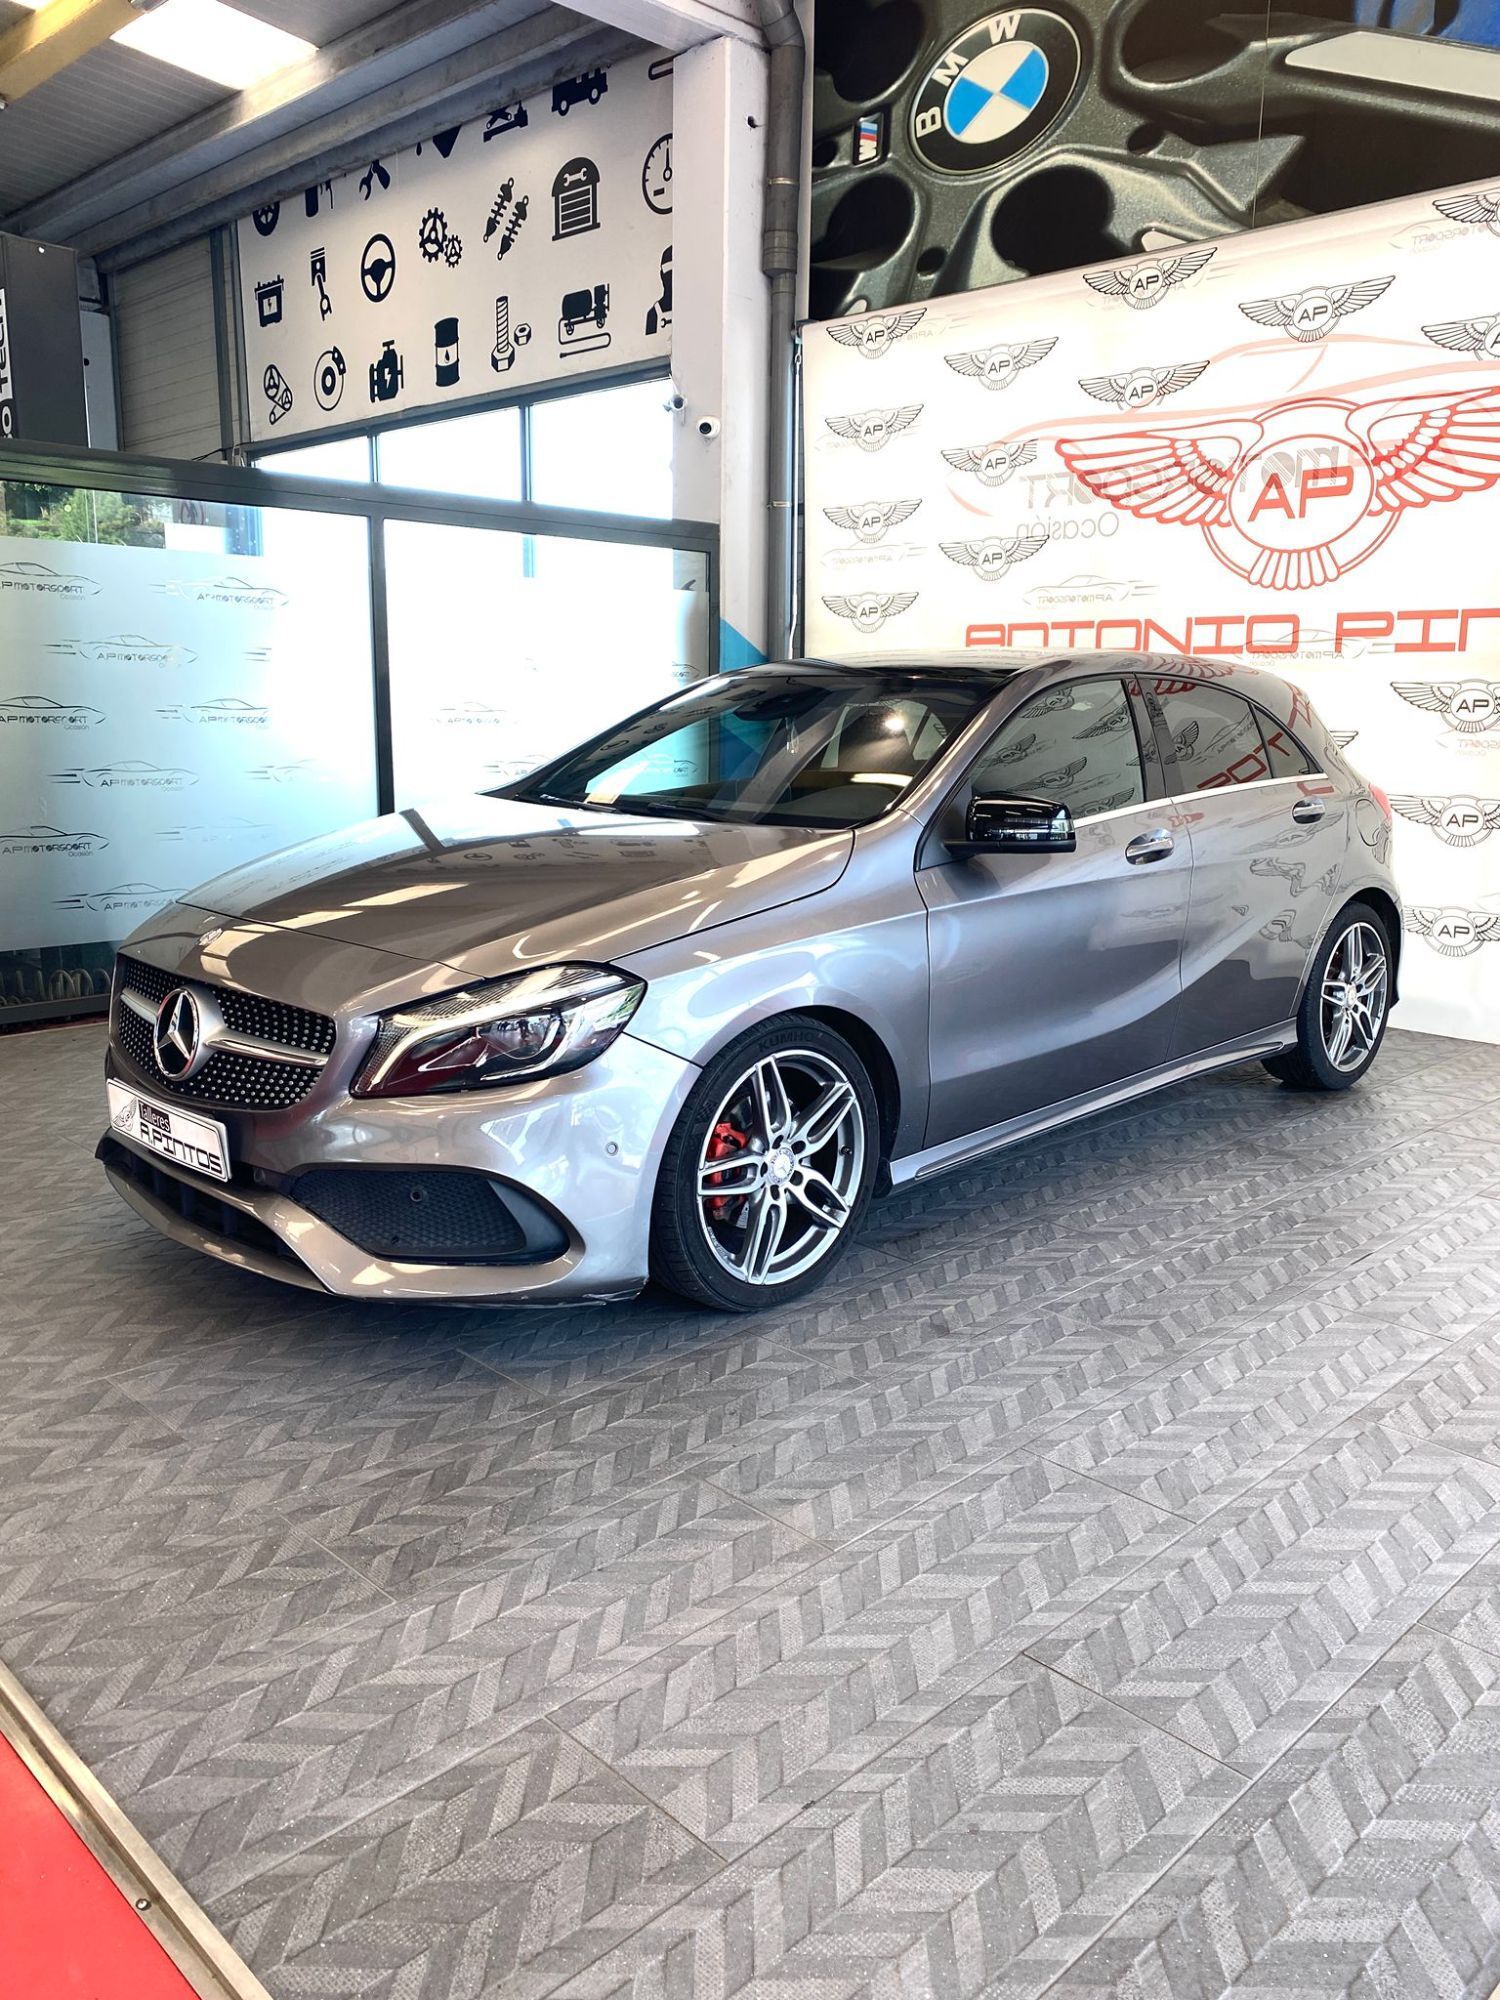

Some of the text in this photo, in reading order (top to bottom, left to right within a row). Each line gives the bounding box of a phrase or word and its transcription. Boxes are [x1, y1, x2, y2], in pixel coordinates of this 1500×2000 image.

[915, 14, 1022, 138] BMW
[1134, 274, 1160, 292] AP
[1298, 305, 1329, 324] AP
[865, 329, 886, 345] AP
[988, 360, 1011, 375] AP
[1129, 385, 1154, 401] AP
[864, 424, 884, 437] AP
[984, 457, 1007, 471] AP
[1248, 465, 1354, 523] AP
[861, 516, 881, 529] AP
[981, 552, 1003, 566] AP
[859, 606, 879, 618] AP
[965, 613, 1301, 655] ANTONIO
[1456, 699, 1490, 713] AP
[1446, 813, 1479, 828] AP
[1438, 924, 1471, 939] AP
[140, 1102, 170, 1132] Talleres
